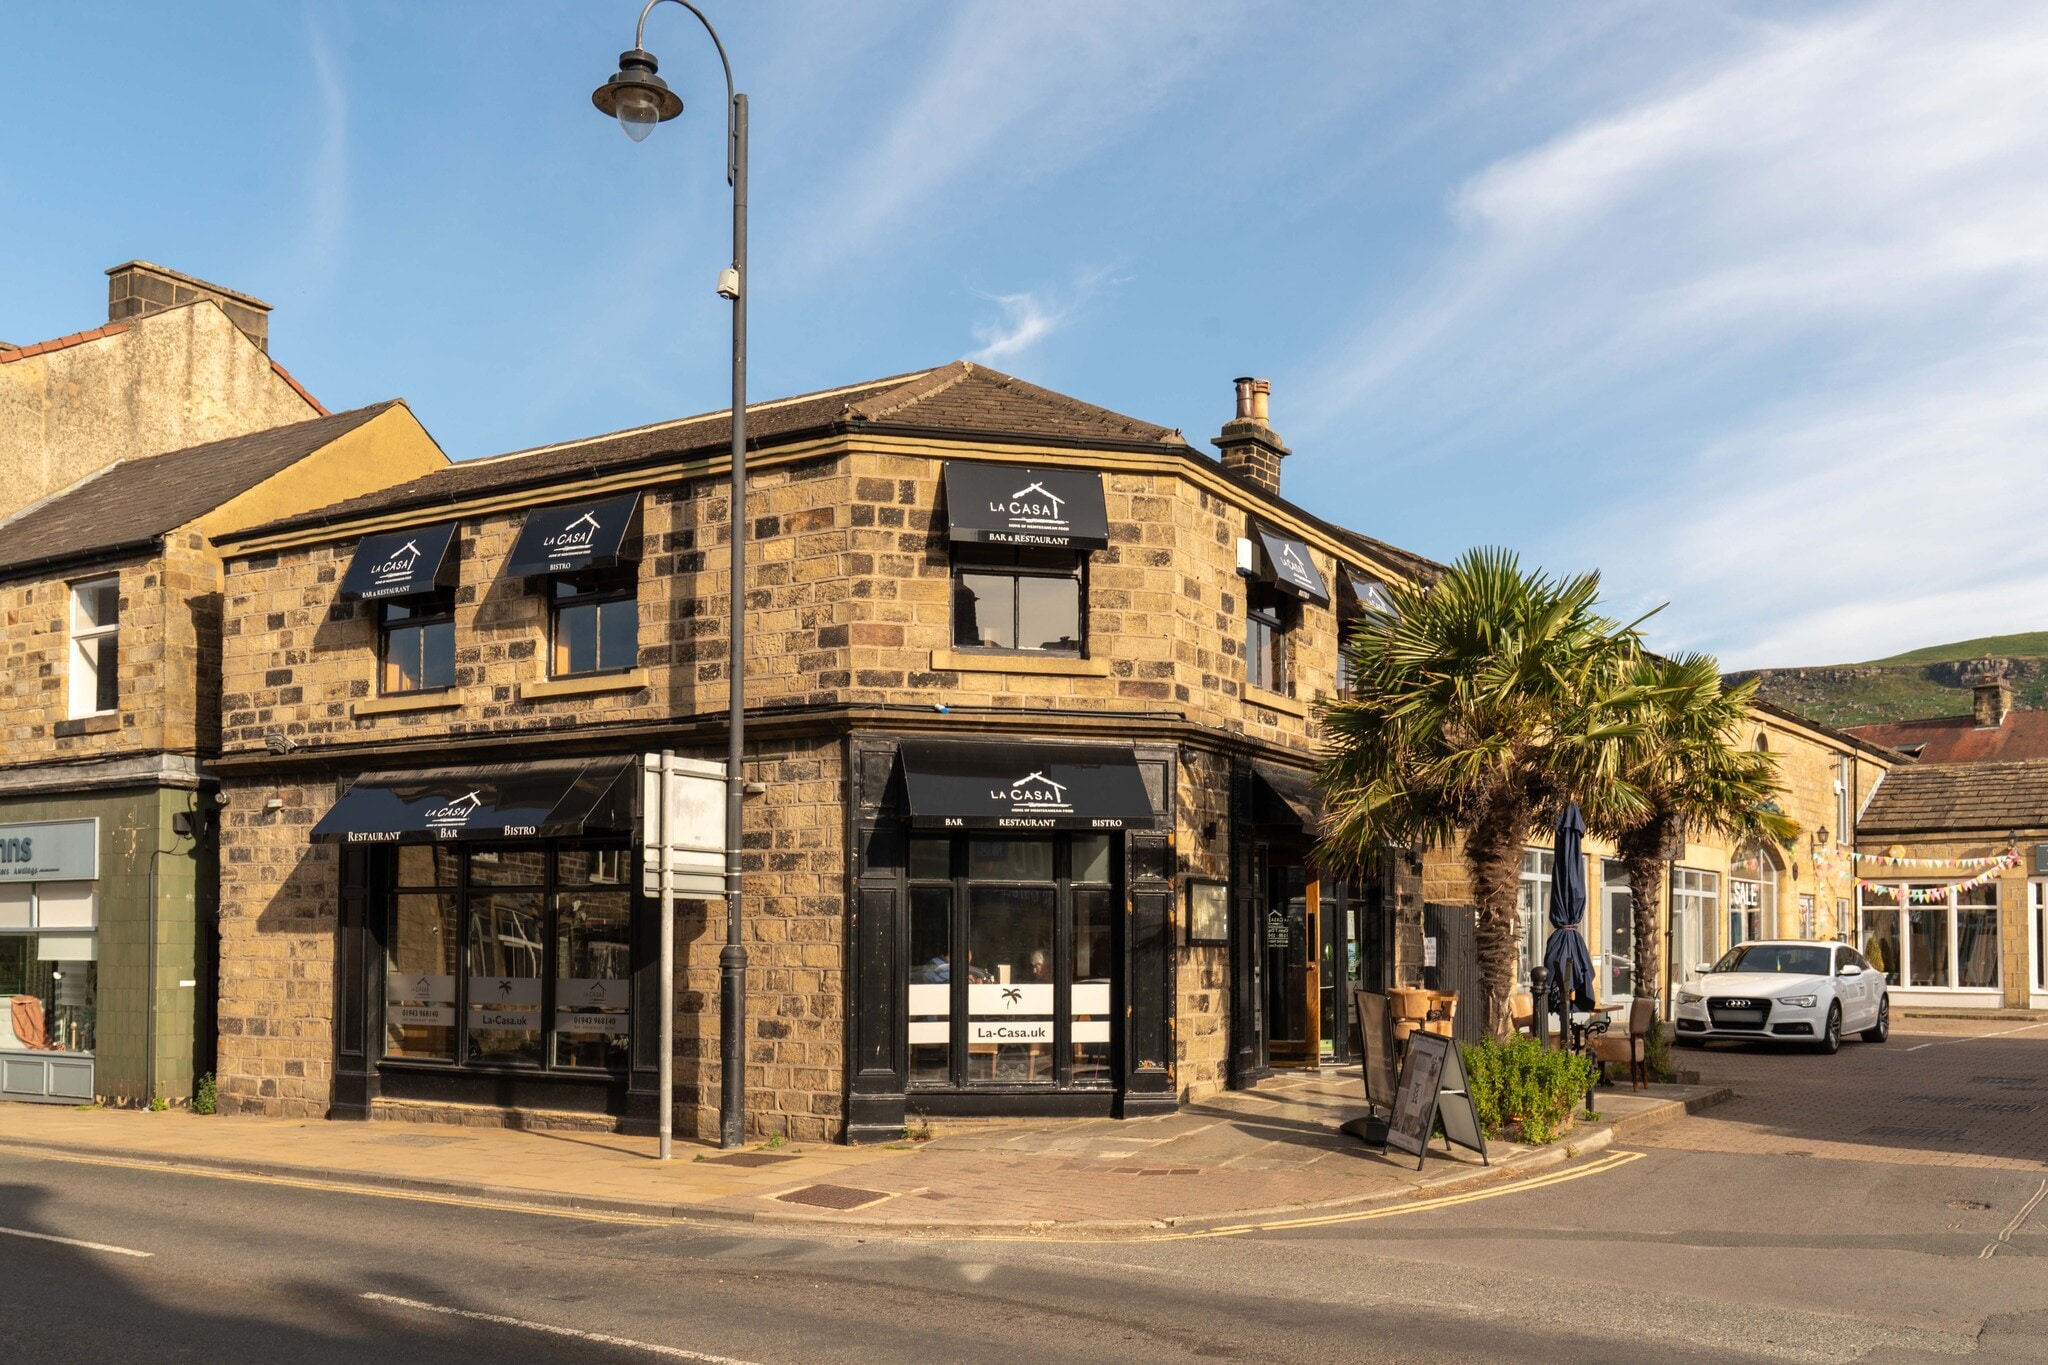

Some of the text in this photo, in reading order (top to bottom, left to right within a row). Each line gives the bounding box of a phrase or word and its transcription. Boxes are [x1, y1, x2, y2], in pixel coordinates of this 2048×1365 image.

[990, 501, 1051, 516] LA CASA
[543, 532, 586, 546] LA CASA
[989, 533, 1006, 541] BAR
[1014, 534, 1070, 545] RESTAURANT
[371, 559, 408, 573] LA CASA
[549, 562, 571, 571] BISTRO
[362, 590, 373, 598] BAR
[377, 585, 411, 596] RESTAURANT
[990, 789, 1053, 801] LA CASA
[424, 807, 464, 817] LA CASA
[945, 818, 1122, 827] BAR RESTAURANT BISTRO
[348, 825, 536, 842] RESTAURANT BAR BISTRO
[1734, 882, 1757, 906] SALE
[482, 1015, 527, 1026] La-Casa.uk
[573, 1017, 616, 1025] 01943 968140
[977, 1027, 1046, 1038] La-Casa.uk
